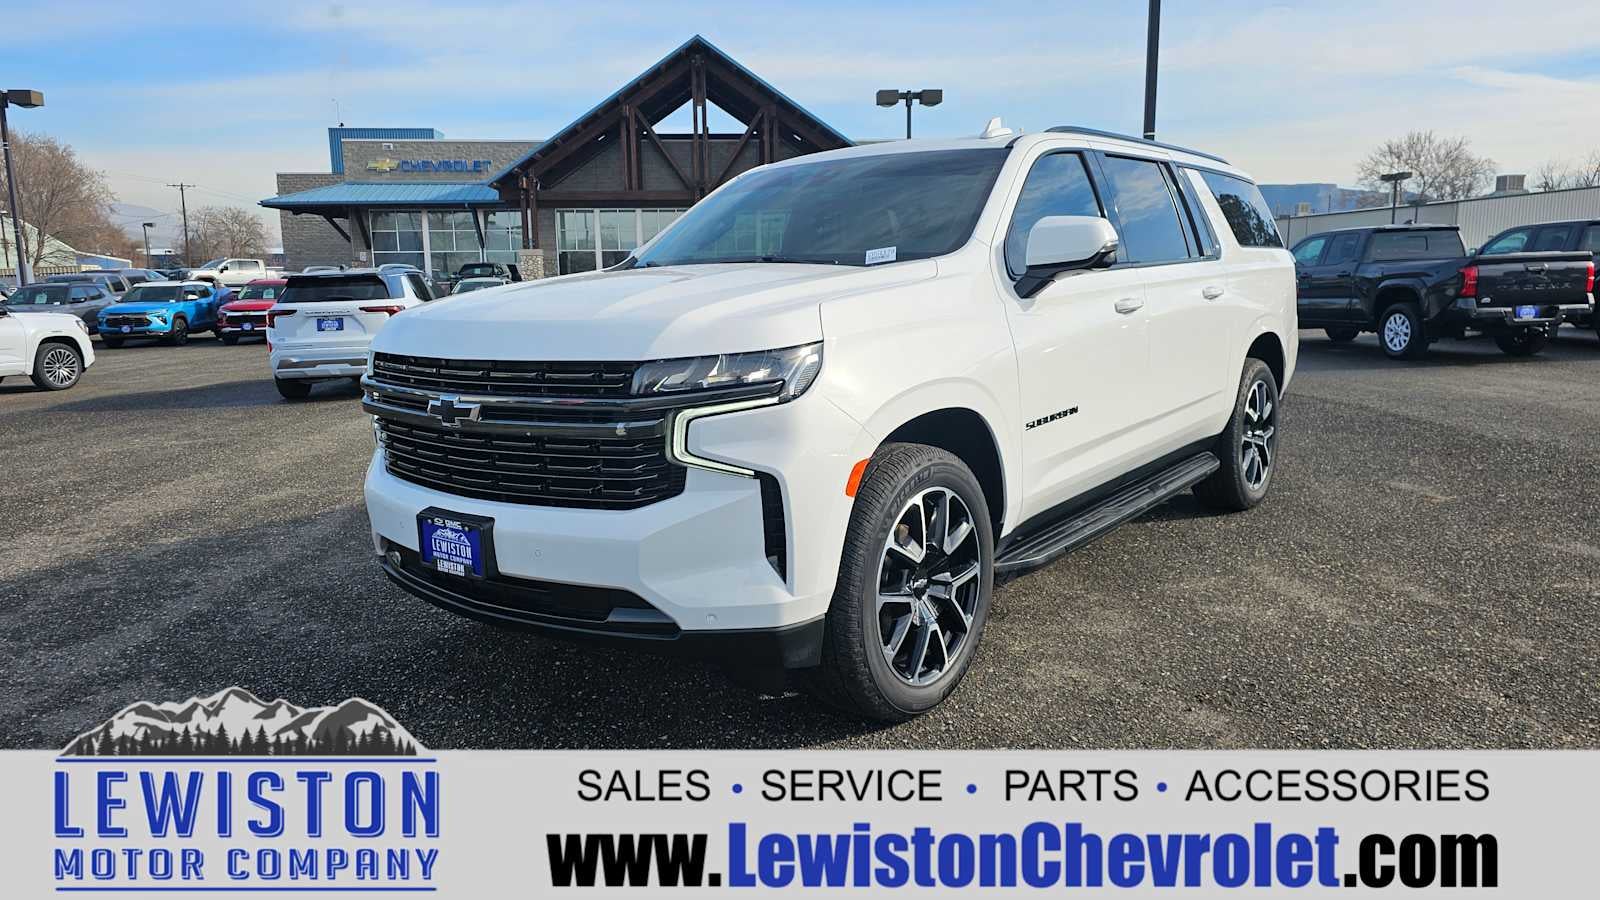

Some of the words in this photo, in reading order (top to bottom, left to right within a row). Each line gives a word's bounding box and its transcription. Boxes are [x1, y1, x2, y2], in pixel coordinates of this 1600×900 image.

[401, 159, 491, 172] CHEVROLET
[1025, 405, 1079, 431] SUBURBAN
[431, 537, 472, 559] LEWISTON
